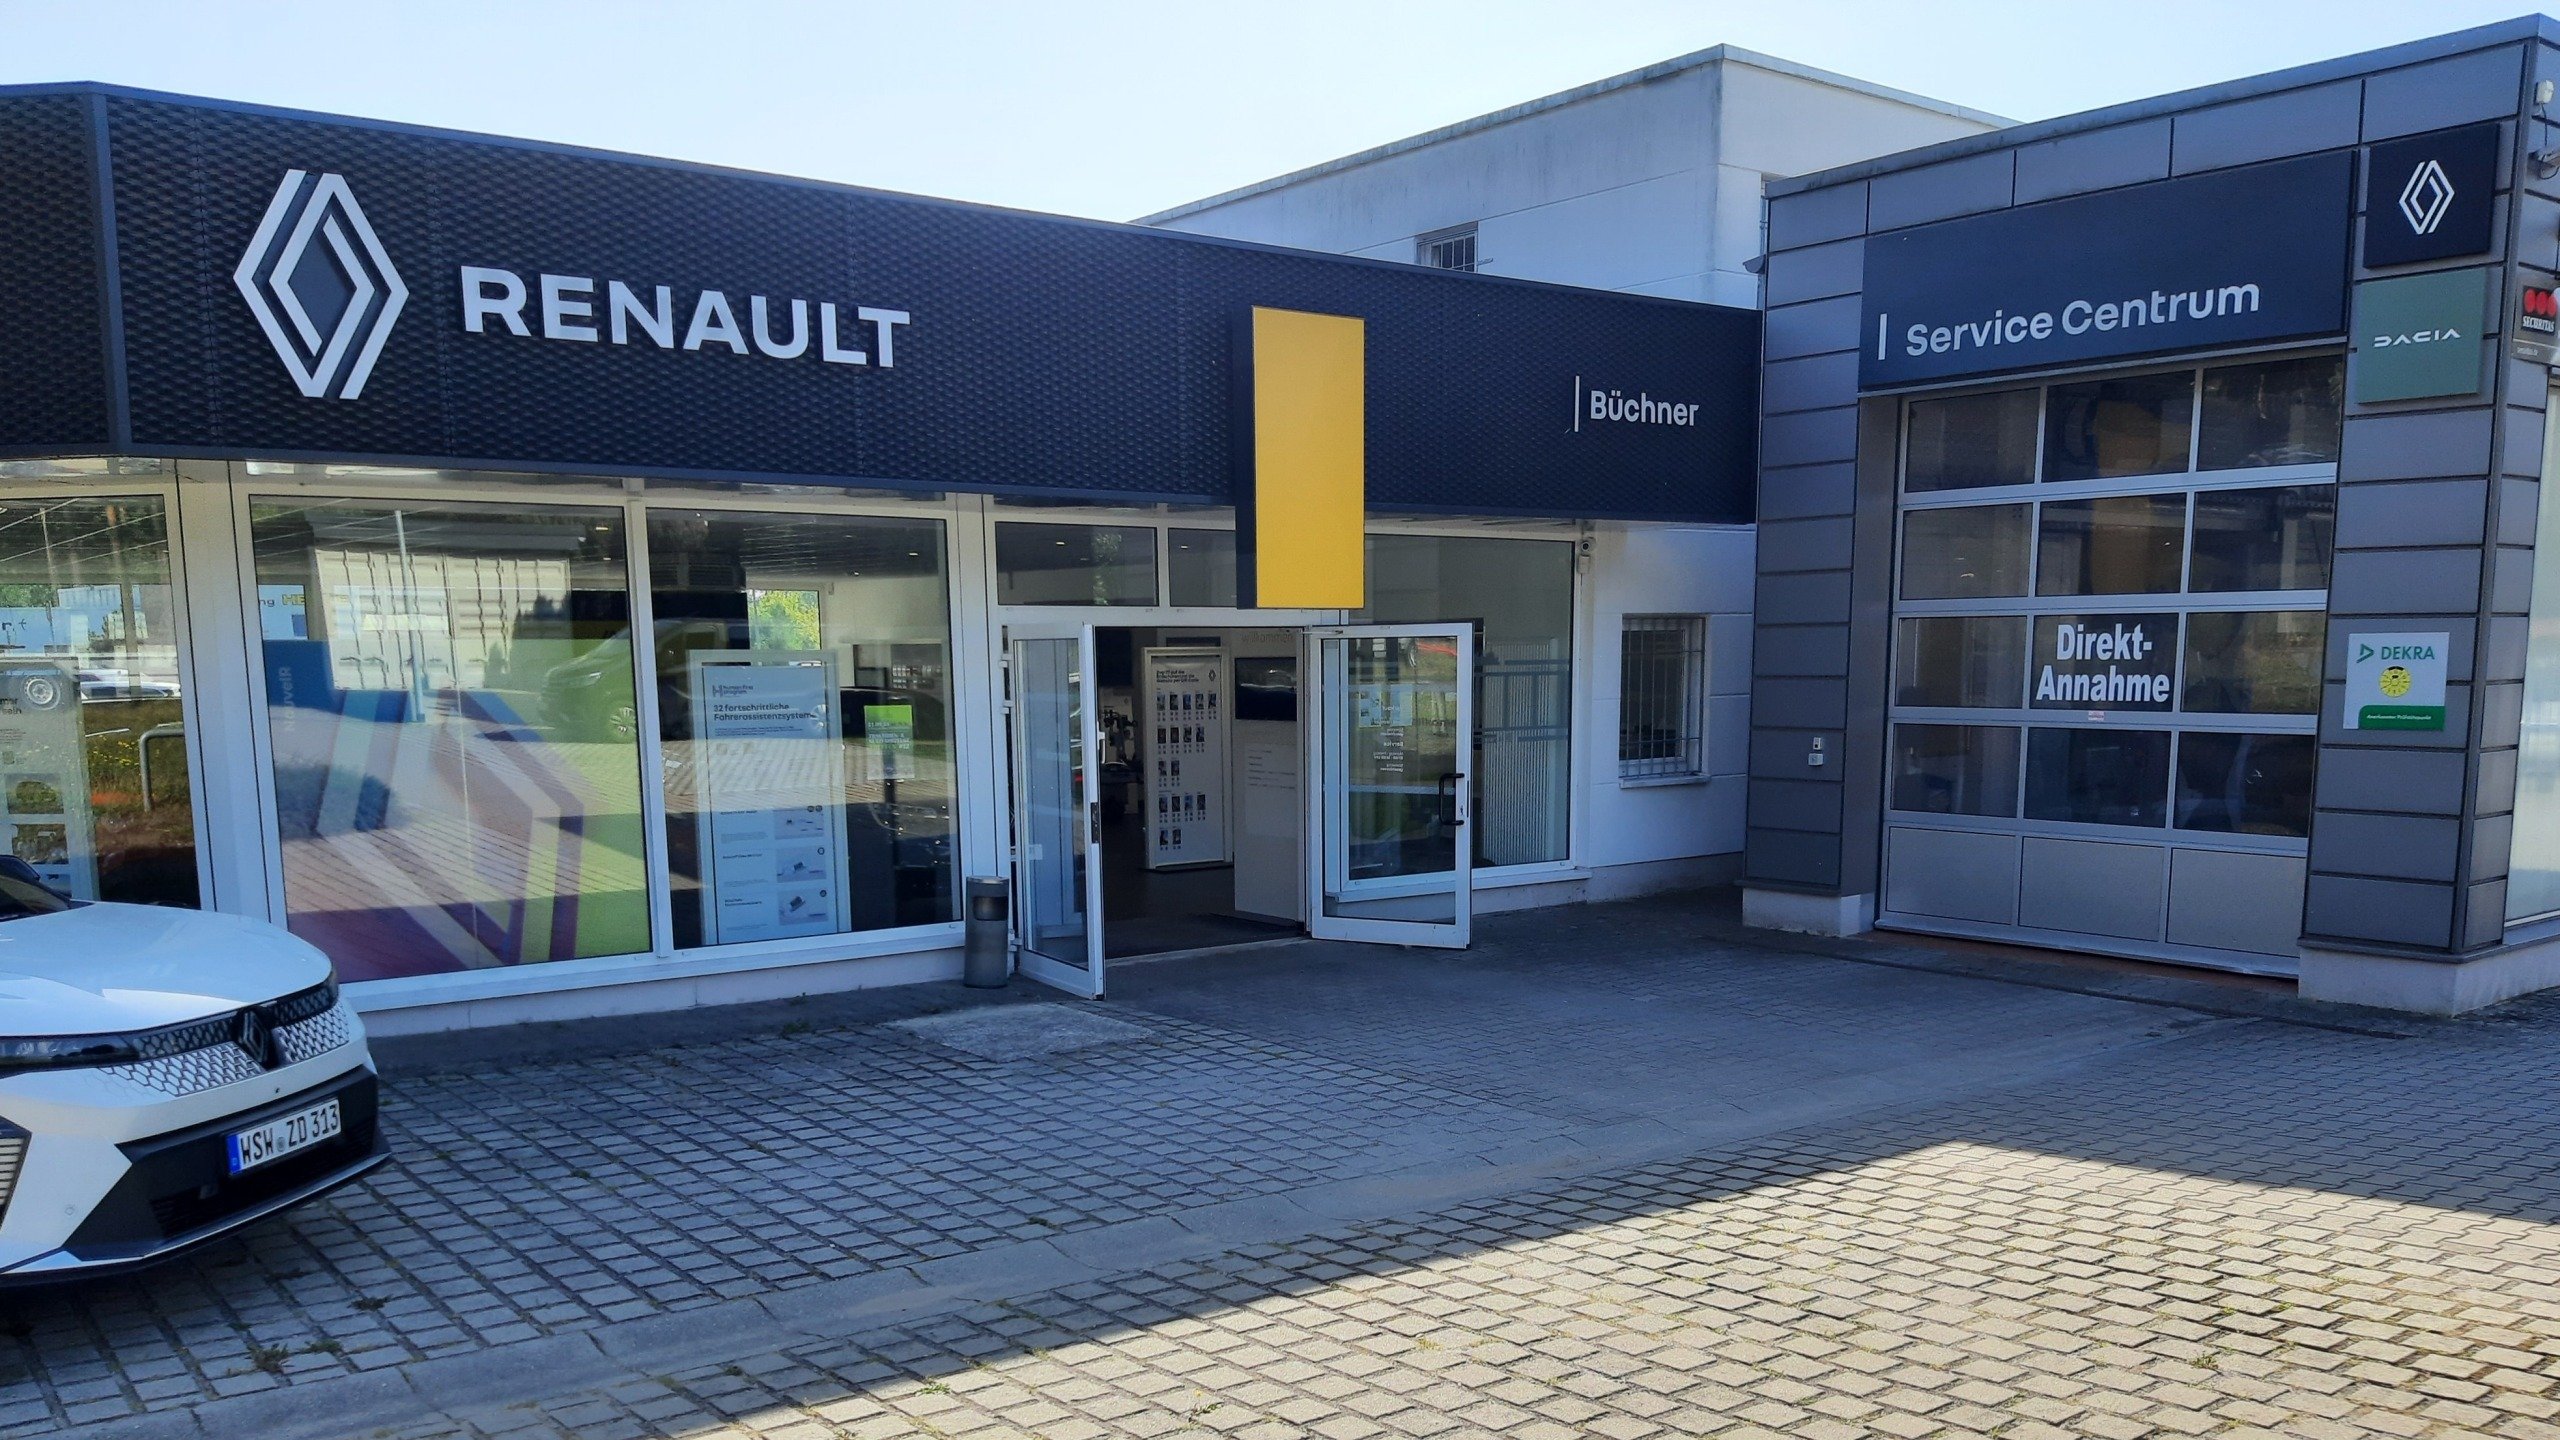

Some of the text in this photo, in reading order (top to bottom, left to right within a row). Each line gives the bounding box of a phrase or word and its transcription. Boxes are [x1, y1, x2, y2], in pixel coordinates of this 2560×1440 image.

[460, 265, 911, 369] RENAULT
[1905, 282, 2260, 357] Service Centrum
[2522, 315, 2555, 333] SECURITAS
[2373, 328, 2462, 348] DACIA
[1590, 389, 1700, 427] Büchner
[2056, 622, 2153, 661] Direkt-
[2381, 646, 2436, 660] DEKRA
[2035, 664, 2170, 703] Annahme
[713, 702, 790, 712] 32 fortschrittliche
[240, 1103, 339, 1165] WSW ZD 313
